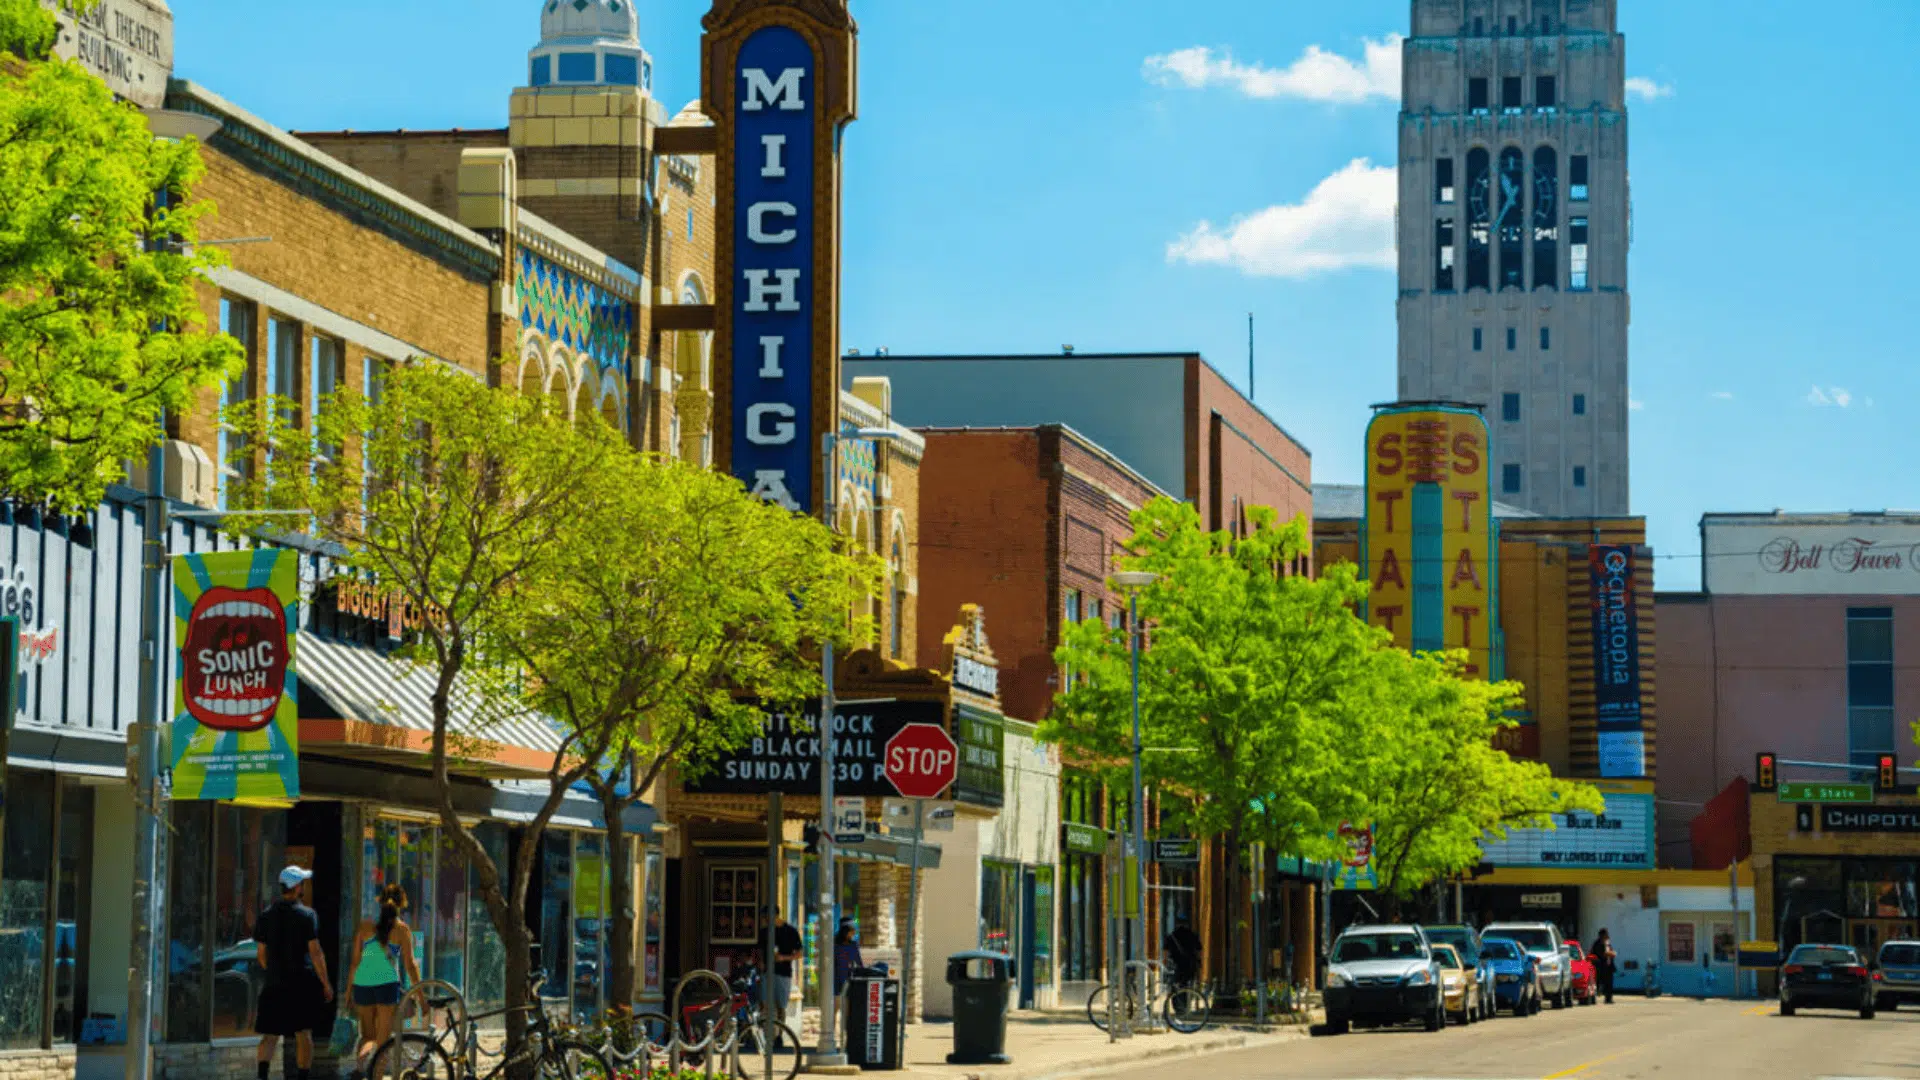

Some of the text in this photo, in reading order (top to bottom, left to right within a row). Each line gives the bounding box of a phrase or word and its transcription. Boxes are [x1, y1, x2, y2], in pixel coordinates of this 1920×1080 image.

[114, 9, 160, 60] THEATER
[78, 29, 132, 83] BUILDING
[741, 66, 806, 512] MICHIGA
[1375, 433, 1404, 647] STAT
[1759, 536, 1823, 574] Bell
[1828, 536, 1904, 574] Tower
[198, 640, 275, 675] SONIC
[203, 671, 267, 696] LUNCH
[725, 760, 811, 780] SUNDAY
[890, 747, 953, 776] STOP
[1819, 787, 1855, 799] State
